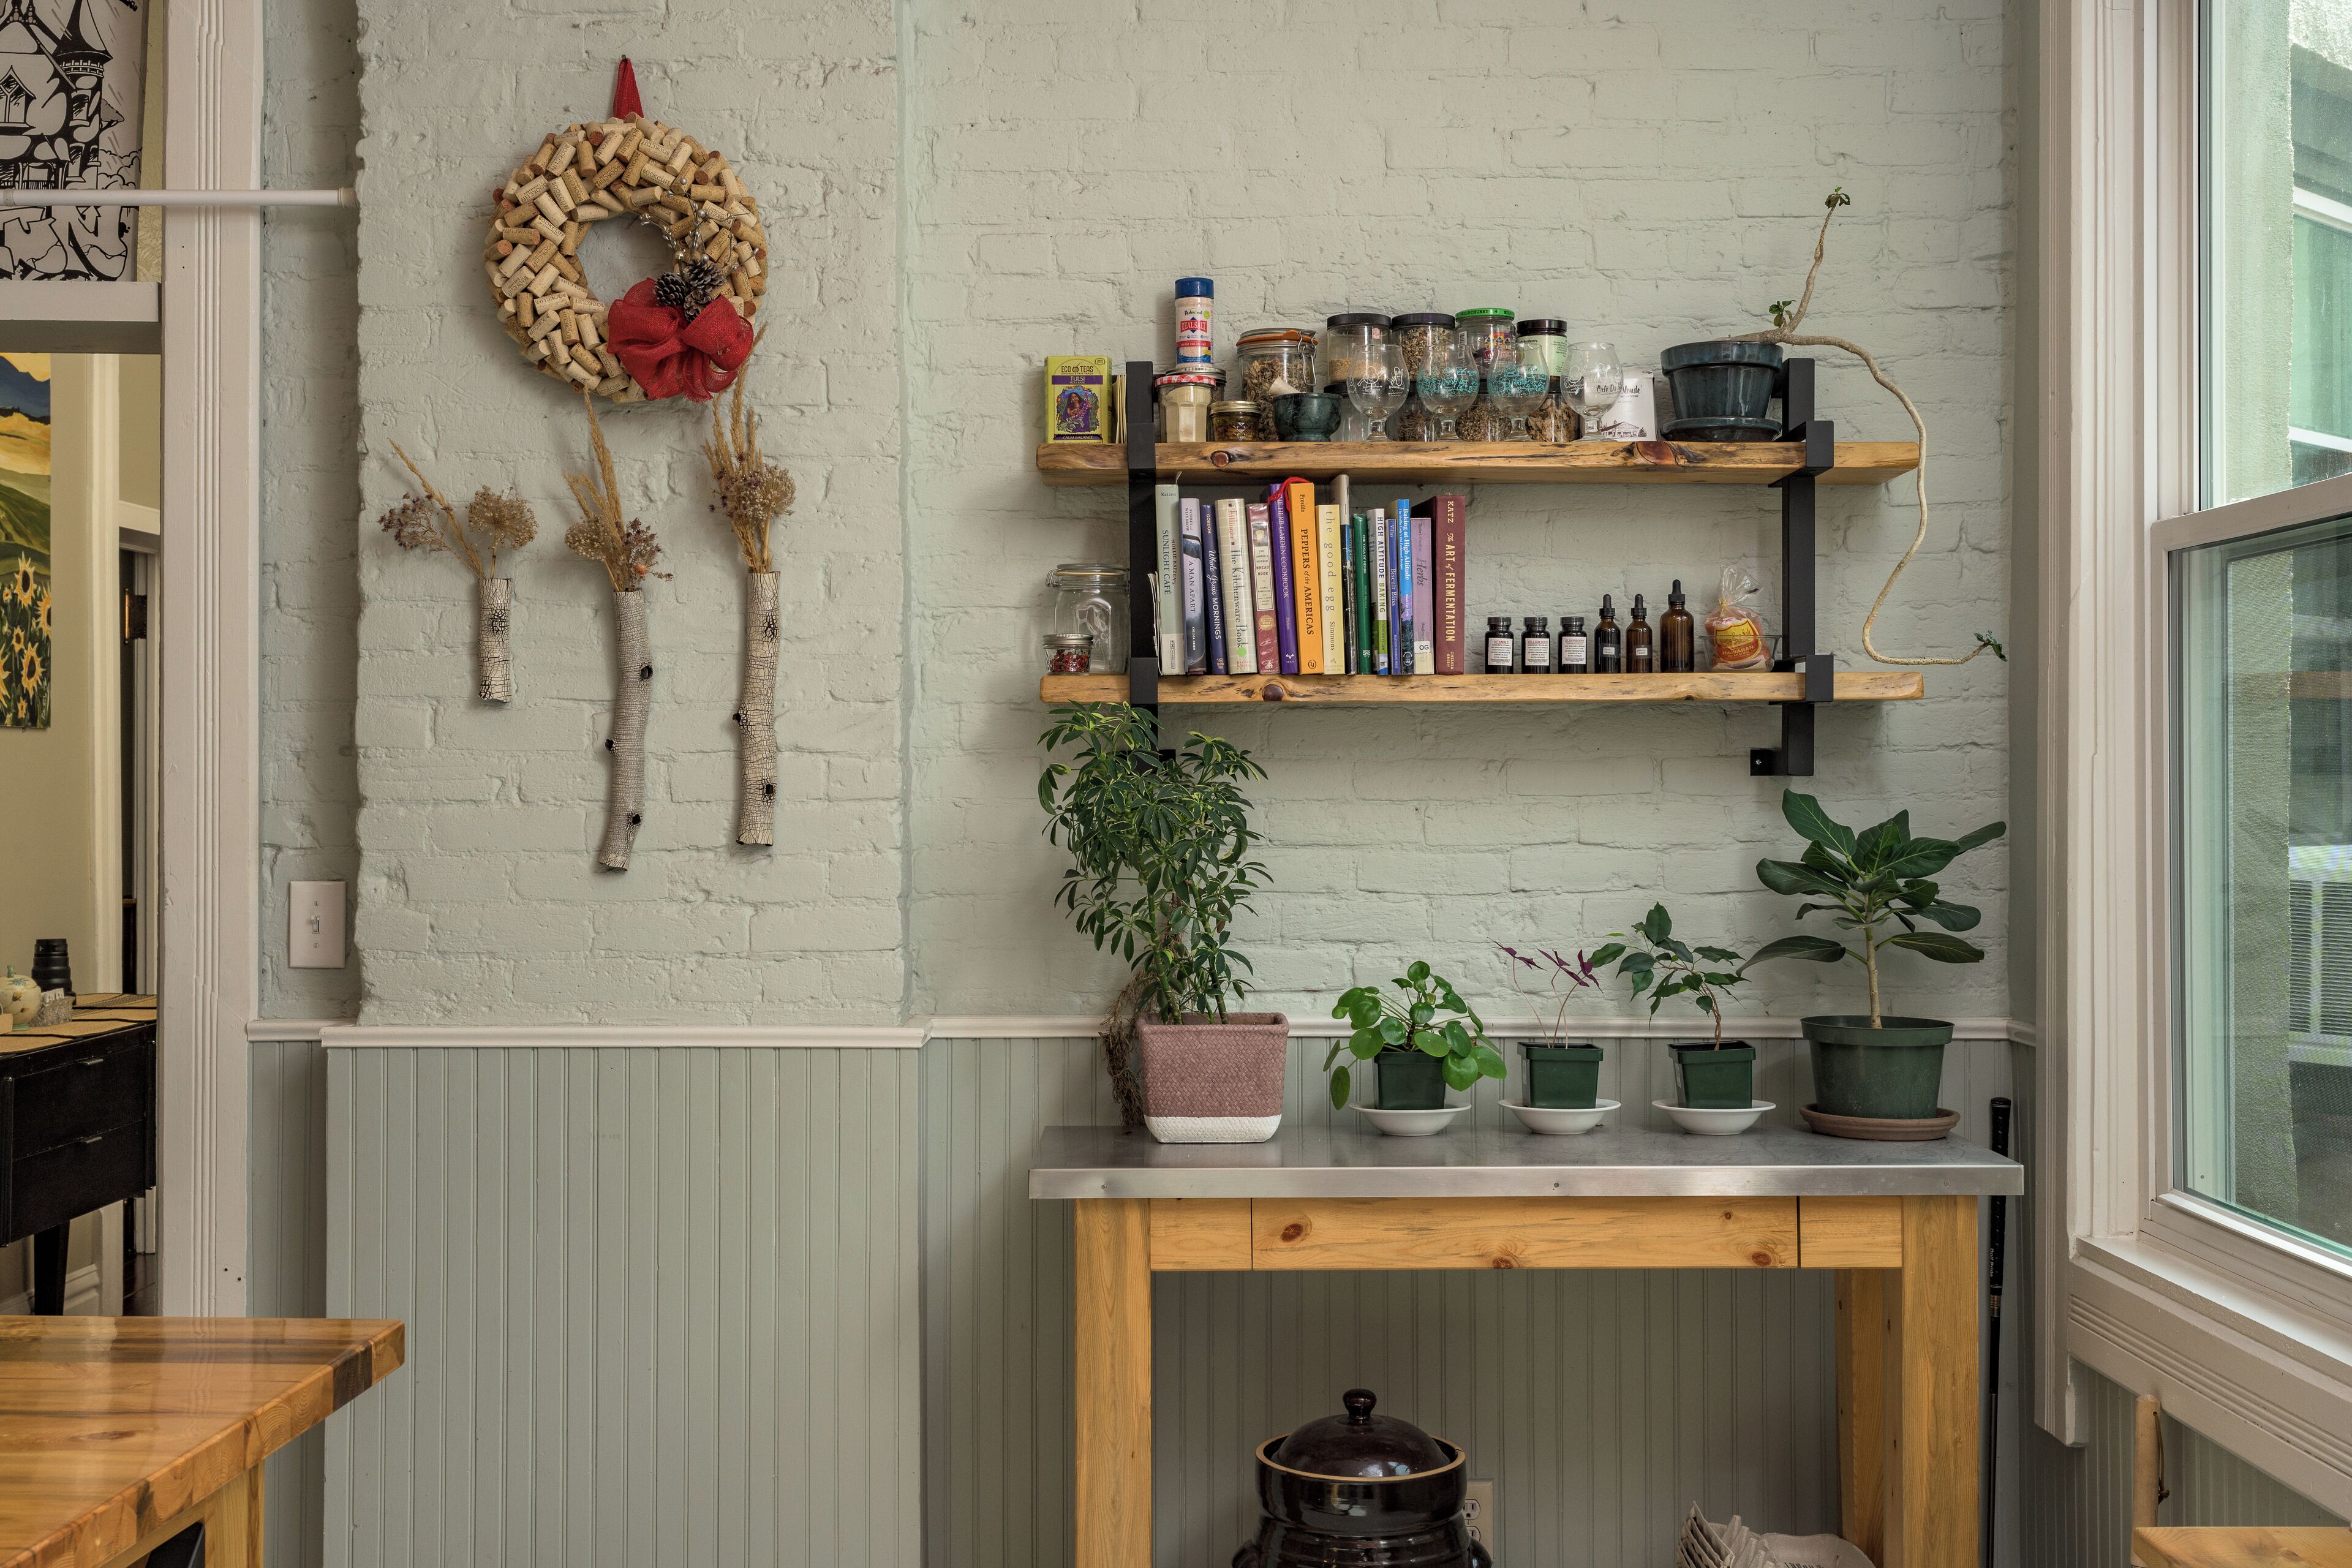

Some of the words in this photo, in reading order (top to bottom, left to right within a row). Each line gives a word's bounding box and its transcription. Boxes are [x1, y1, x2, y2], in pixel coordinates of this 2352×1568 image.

[1622, 385, 1640, 394] Monde
[1326, 511, 1335, 533] the
[1231, 548, 1242, 565] The
[1301, 529, 1310, 569] PEPPERS
[1324, 543, 1336, 577] good
[1446, 545, 1455, 562] ART
[1207, 550, 1218, 595] Whole-Grain
[1281, 557, 1289, 598] COOKBOOK
[1416, 557, 1427, 586] Herbs
[1232, 568, 1245, 623] Kitchenware
[1304, 586, 1314, 635] AMERICAS
[1325, 587, 1334, 611] egg
[1446, 573, 1455, 641] FERMENTATION
[1212, 598, 1221, 639] MORNINGS
[1236, 625, 1249, 648] Book
[1722, 645, 1754, 655] HAWAIIAN
